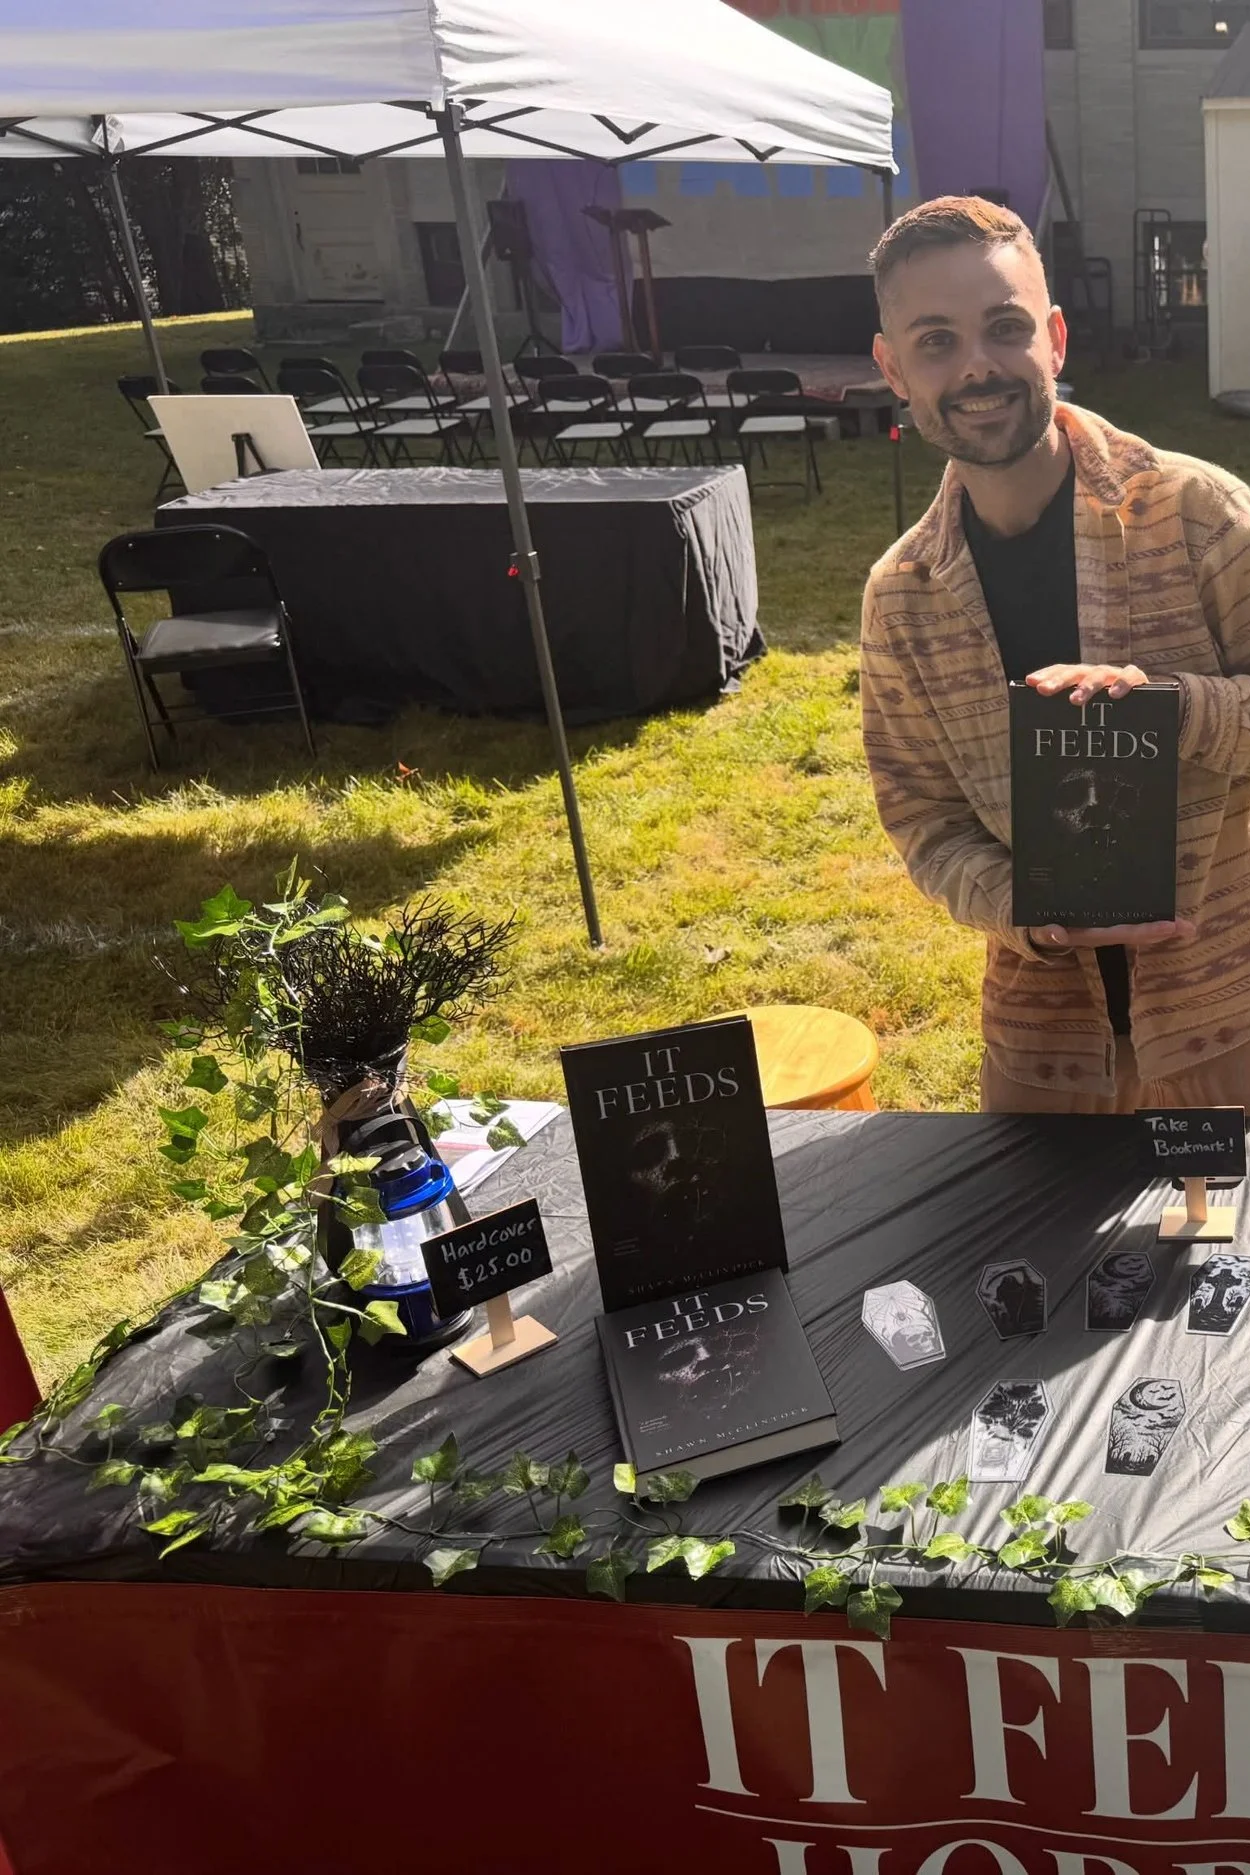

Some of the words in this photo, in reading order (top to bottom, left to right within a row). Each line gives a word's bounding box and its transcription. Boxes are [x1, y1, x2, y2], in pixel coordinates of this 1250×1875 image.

[1080, 702, 1113, 727] IT
[1034, 728, 1159, 760] FEEDS
[642, 1046, 681, 1077] IT
[594, 1067, 740, 1120] FEEDS
[1144, 1116, 1189, 1132] Take
[1201, 1121, 1213, 1133] a
[1152, 1137, 1234, 1157] Bookmark!
[457, 1247, 532, 1291] $25.00
[671, 1292, 709, 1316] IT
[624, 1293, 769, 1349] FEEDS
[655, 1438, 707, 1457] SHAWN
[673, 1635, 888, 1804] IT
